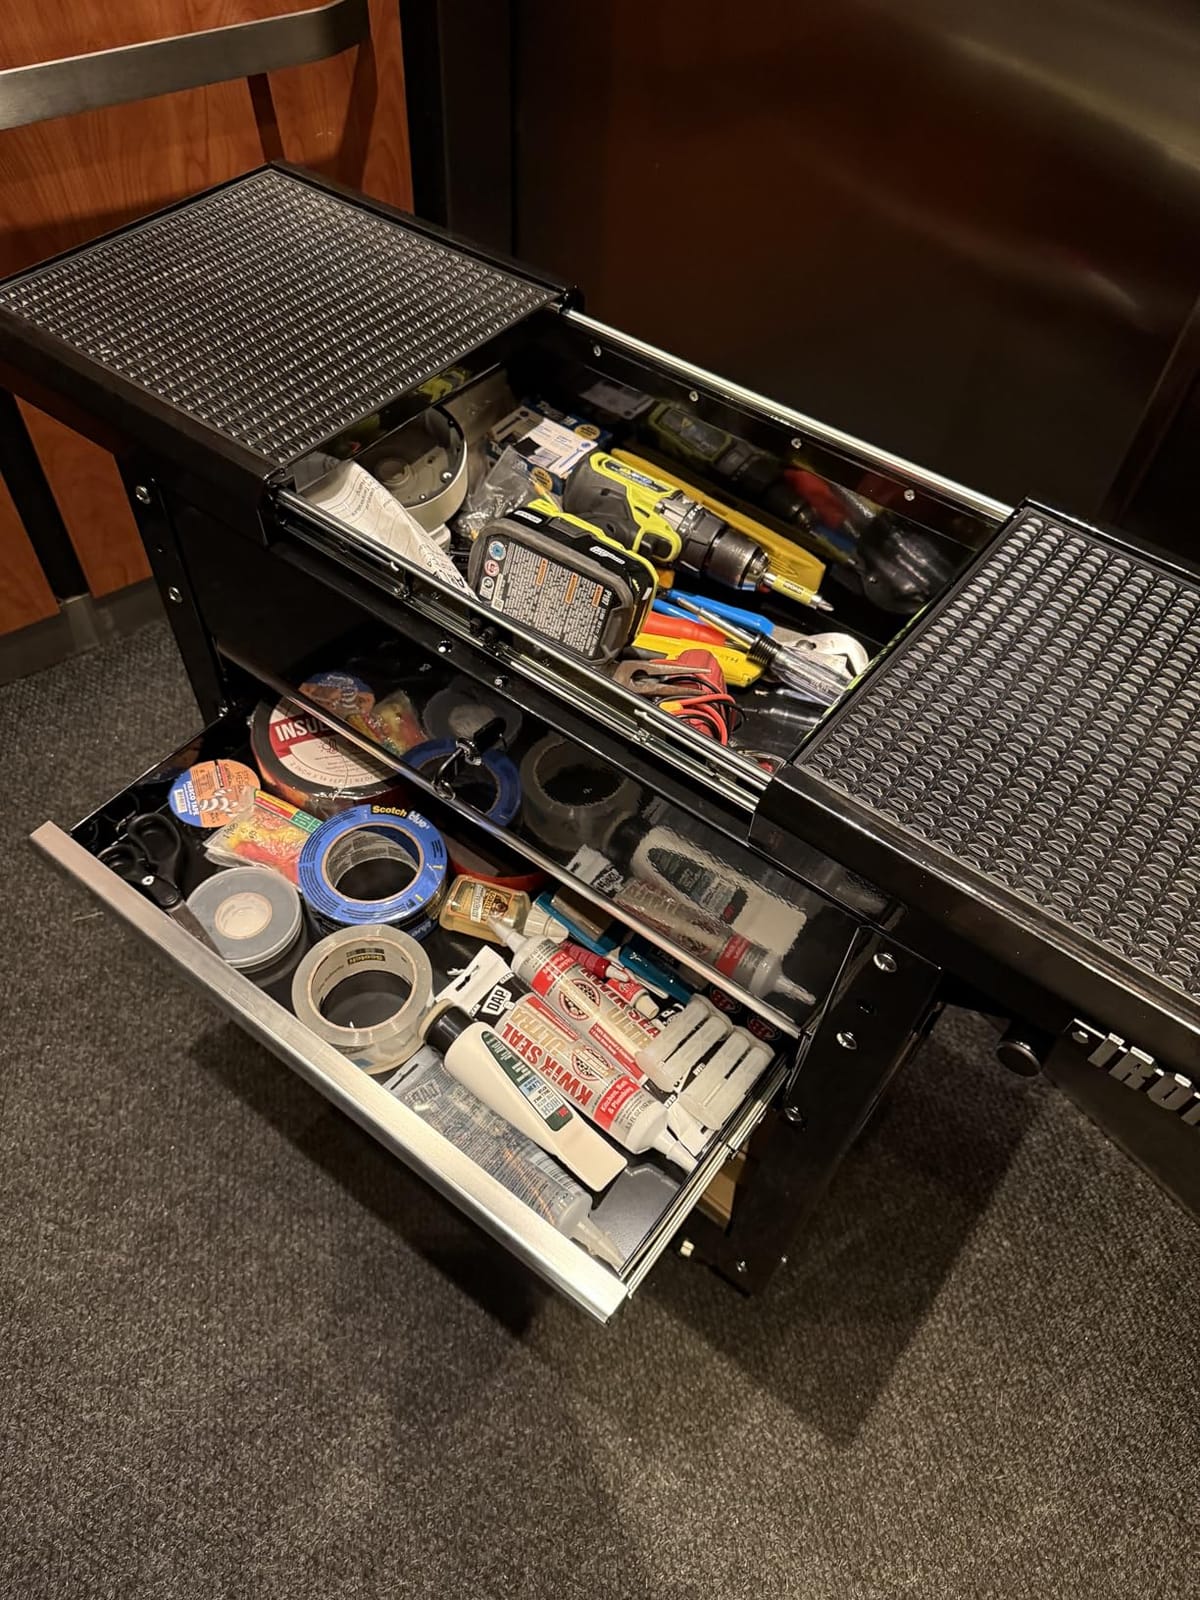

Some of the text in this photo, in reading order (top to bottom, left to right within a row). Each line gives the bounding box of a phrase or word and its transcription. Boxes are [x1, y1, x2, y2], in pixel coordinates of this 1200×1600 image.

[275, 715, 335, 742] INSUL
[371, 804, 408, 818] Scotch
[486, 990, 504, 1011] DAP
[502, 1023, 543, 1065] SEAL
[511, 1007, 567, 1056] ULTRA
[540, 1056, 593, 1106] KWIK
[541, 1097, 561, 1116] HIGH
[611, 1085, 634, 1109] Plumbing
